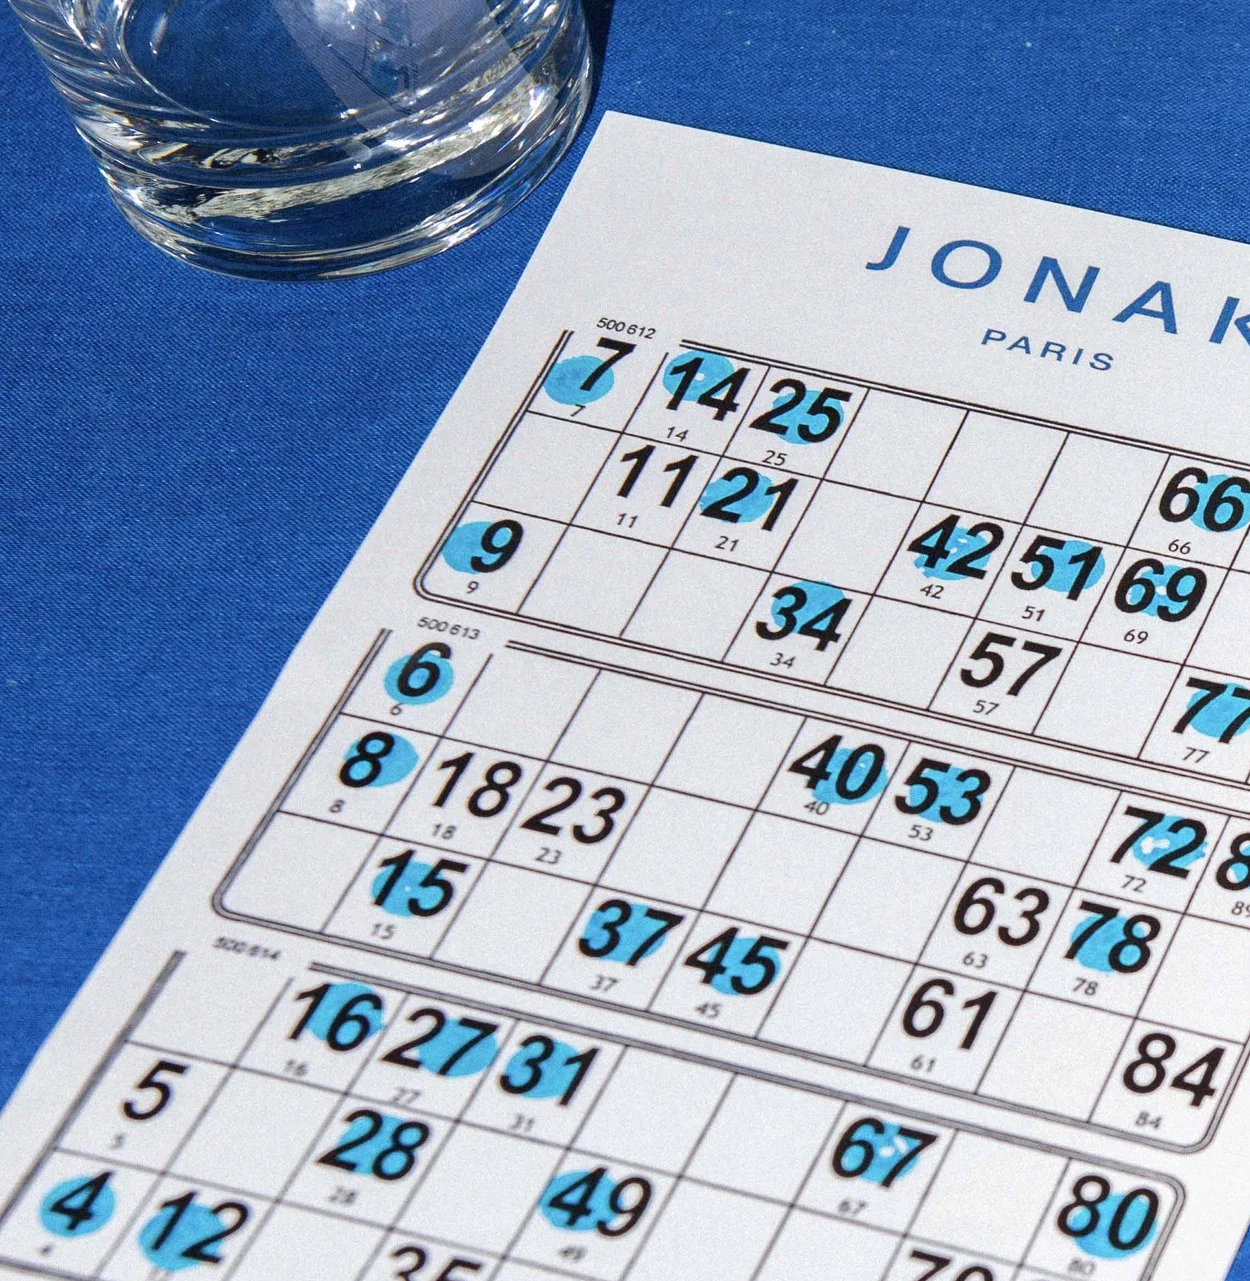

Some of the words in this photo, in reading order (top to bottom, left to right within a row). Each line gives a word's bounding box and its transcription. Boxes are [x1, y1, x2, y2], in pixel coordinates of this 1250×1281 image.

[579, 336, 637, 392] 7
[981, 328, 1114, 371] PARIS
[569, 402, 587, 418] 7
[666, 357, 751, 422] 14
[748, 378, 853, 443] 25
[665, 426, 690, 443] 14
[760, 449, 789, 467] 25
[617, 444, 699, 508] 11
[699, 466, 799, 532] 21
[470, 519, 524, 574] 9
[616, 512, 639, 529] 11
[713, 535, 740, 553] 21
[906, 513, 1005, 580] 42
[1167, 538, 1192, 556] 66
[465, 580, 480, 595] 9
[919, 583, 945, 600] 42
[1010, 534, 1103, 602] 51
[1114, 557, 1208, 623] 69
[755, 585, 853, 652] 34
[1020, 605, 1046, 623] 51
[1123, 628, 1149, 645] 69
[397, 642, 452, 698] 6
[768, 651, 797, 670] 34
[960, 631, 1063, 697] 57
[388, 702, 404, 717] 6
[972, 699, 1001, 716] 57
[338, 731, 395, 789] 8
[788, 734, 886, 801] 40
[1181, 746, 1211, 764] 77
[328, 798, 346, 814] 8
[432, 752, 522, 818] 18
[520, 776, 626, 845] 23
[803, 800, 830, 817] 40
[894, 757, 991, 826] 53
[432, 822, 457, 841] 18
[533, 846, 563, 866] 23
[907, 823, 934, 842] 53
[1110, 805, 1208, 880] 72
[373, 849, 468, 918] 15
[953, 877, 1050, 947] 63
[1120, 874, 1148, 894] 72
[370, 922, 395, 941] 15
[578, 898, 685, 967] 37
[961, 951, 989, 970] 63
[1063, 900, 1162, 974] 78
[590, 974, 620, 992] 37
[683, 926, 790, 996] 45
[1072, 976, 1099, 997] 78
[289, 983, 382, 1052] 16
[381, 1008, 498, 1077] 27
[902, 978, 998, 1051] 61
[123, 1060, 188, 1121] 5
[499, 1034, 599, 1107] 31
[909, 1054, 937, 1073] 61
[1122, 1032, 1225, 1107] 84
[316, 1109, 430, 1181] 28
[1134, 1110, 1163, 1130] 84
[831, 1117, 938, 1189] 67
[49, 1171, 112, 1231] 4
[151, 1191, 249, 1265] 12
[548, 1167, 652, 1238] 49
[837, 1200, 867, 1216] 67
[1057, 1175, 1159, 1251] 80
